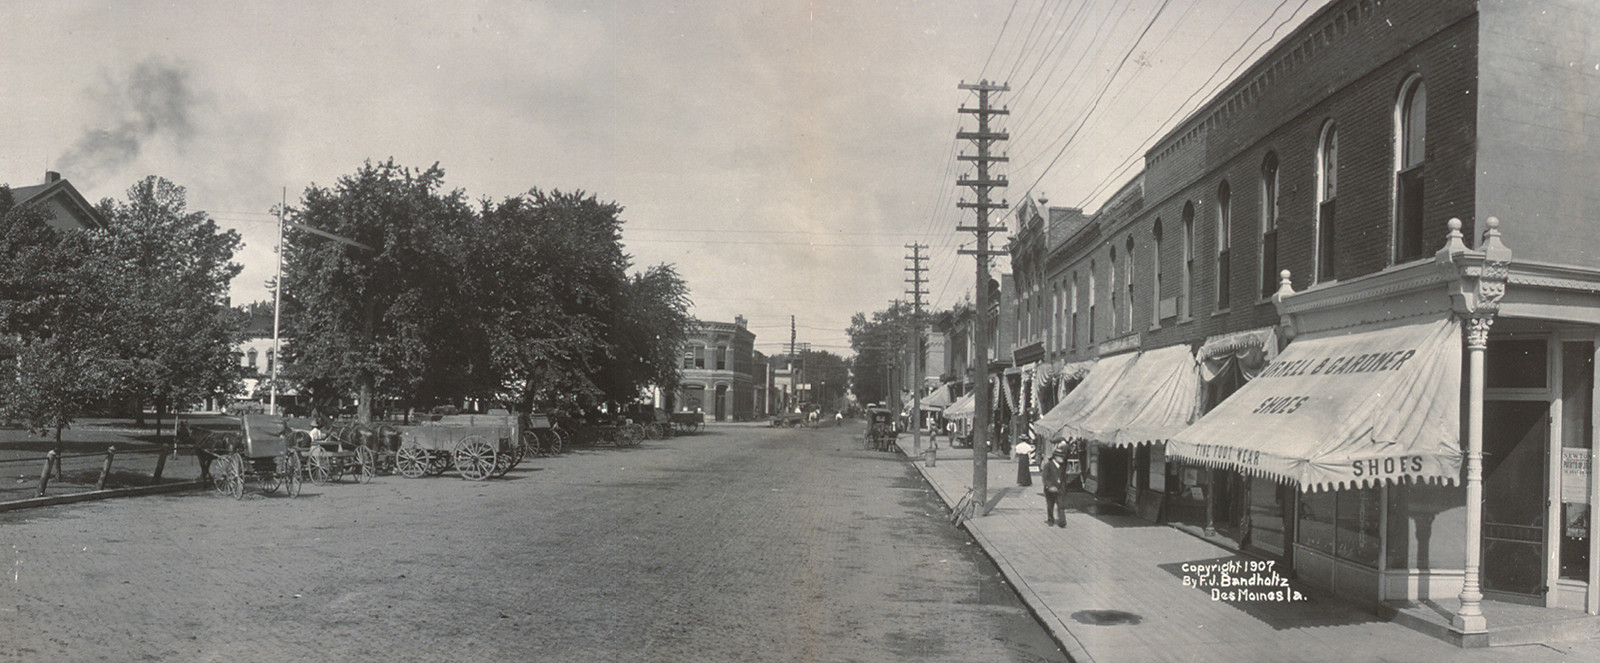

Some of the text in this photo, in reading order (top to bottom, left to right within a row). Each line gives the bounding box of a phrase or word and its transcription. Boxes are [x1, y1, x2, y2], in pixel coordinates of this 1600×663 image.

[1310, 358, 1330, 375] &
[1324, 350, 1417, 375] GARDNER
[1252, 396, 1310, 414] SHOES
[1195, 443, 1260, 466] FINE FOOT WEAR
[1352, 455, 1423, 477] SHOES
